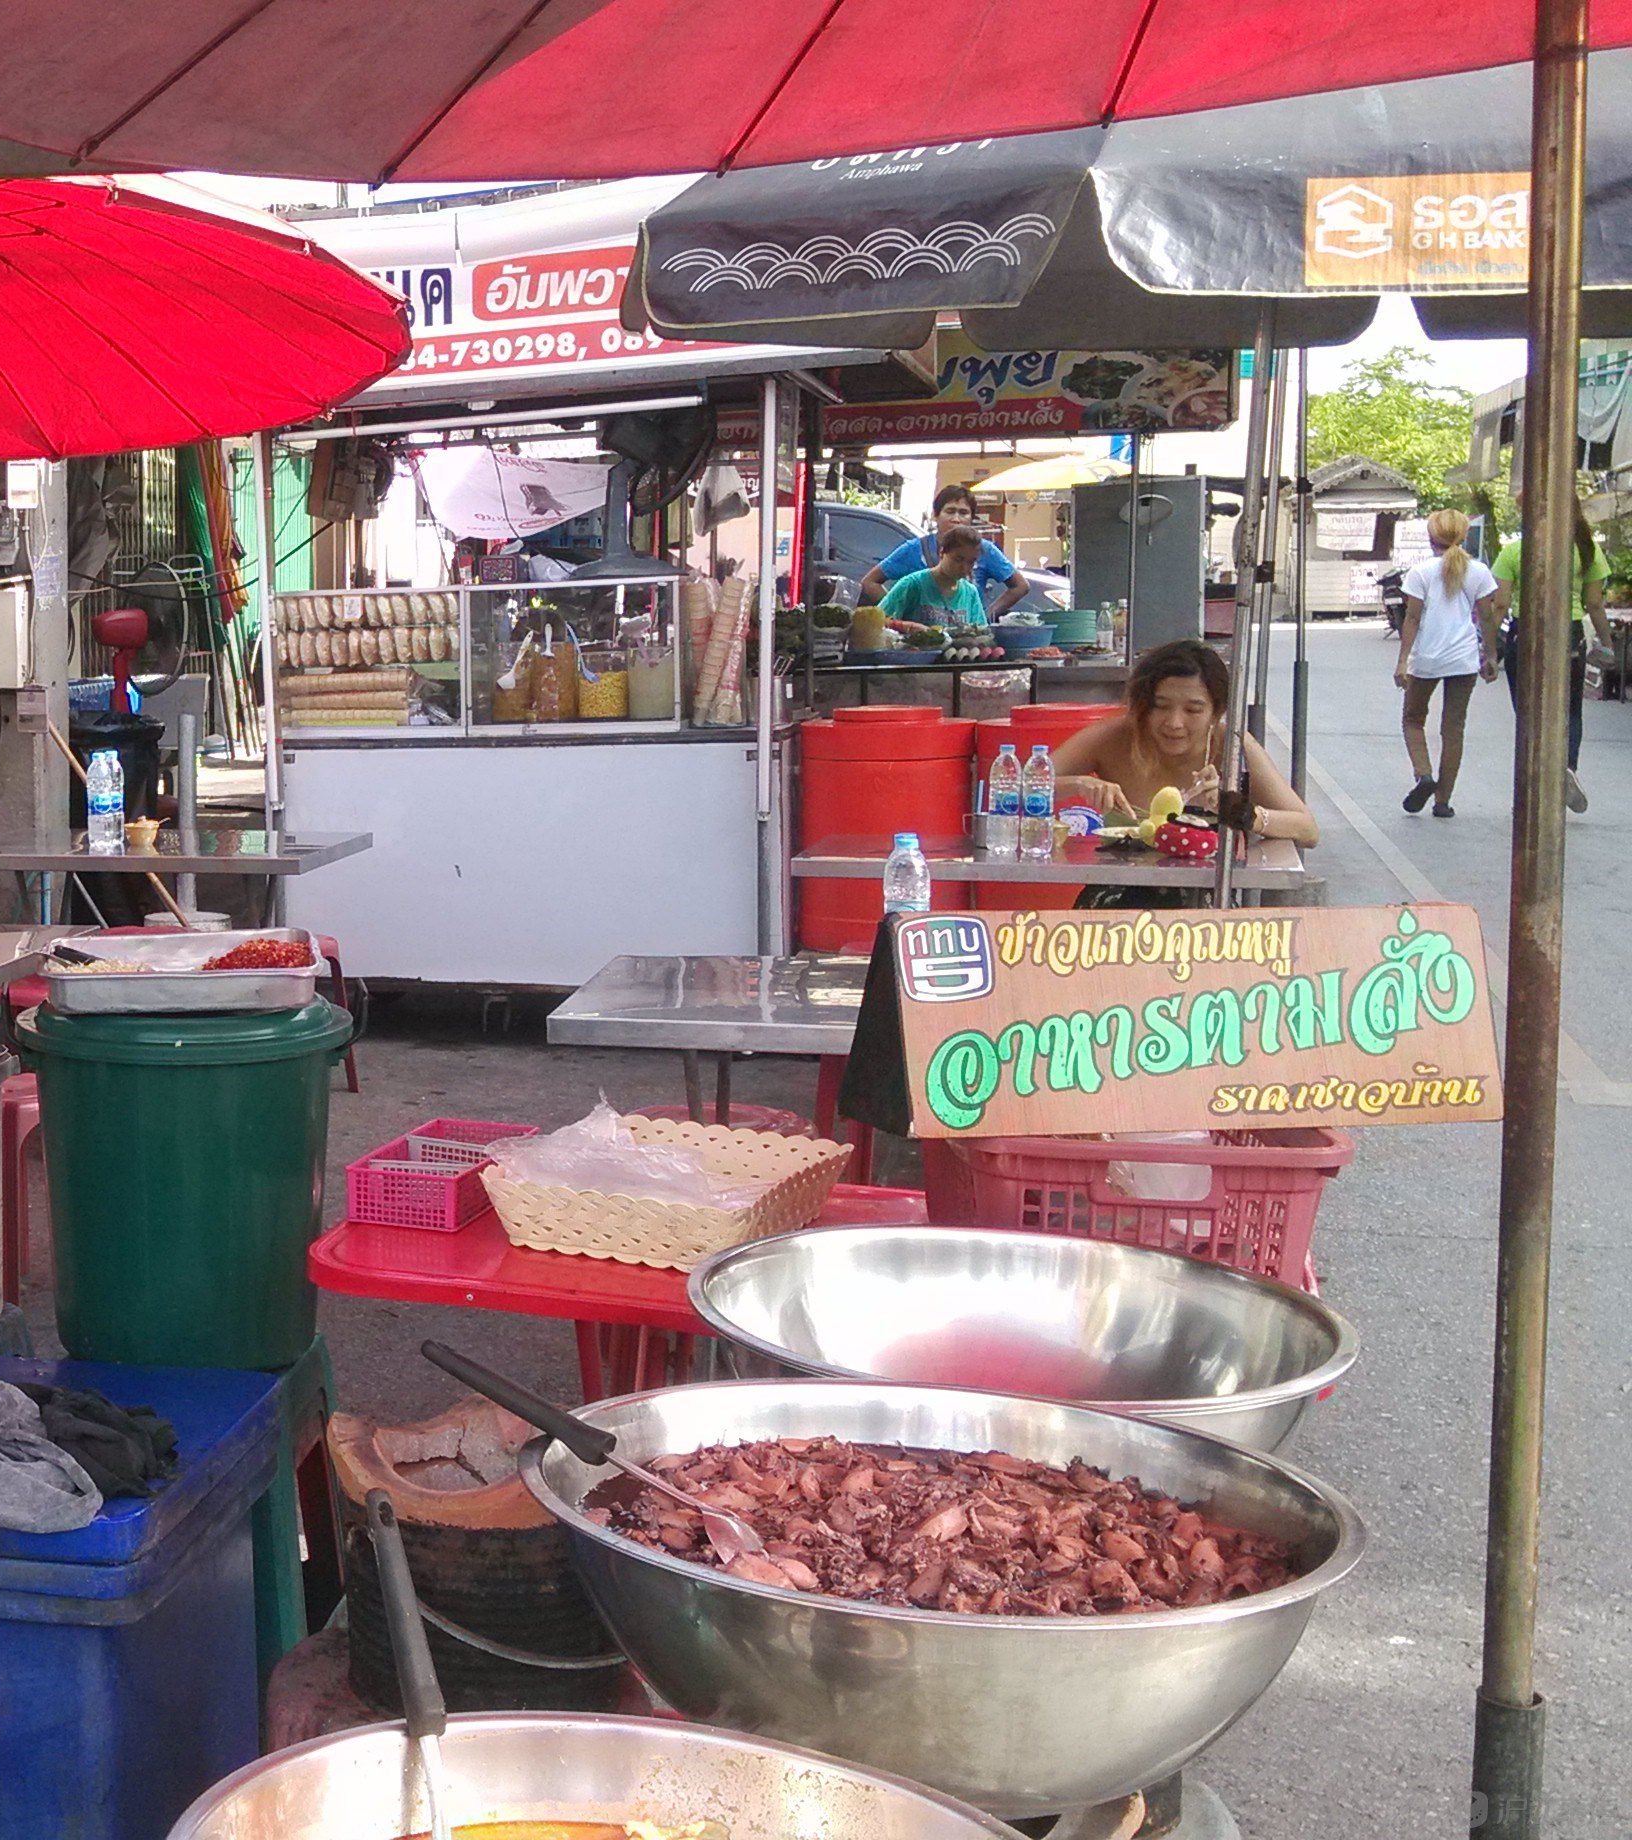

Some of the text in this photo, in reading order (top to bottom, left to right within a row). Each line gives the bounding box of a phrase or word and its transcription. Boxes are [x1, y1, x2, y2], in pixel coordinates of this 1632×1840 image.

[839, 161, 924, 181] Amphawa
[1463, 229, 1527, 250] BANK
[896, 398, 1065, 435] อาหารตามสั่ง
[997, 911, 1295, 982] ข้าวแกงคุณหมู
[910, 954, 985, 997] 5
[925, 909, 1477, 1129] อาหารตามสั่ง
